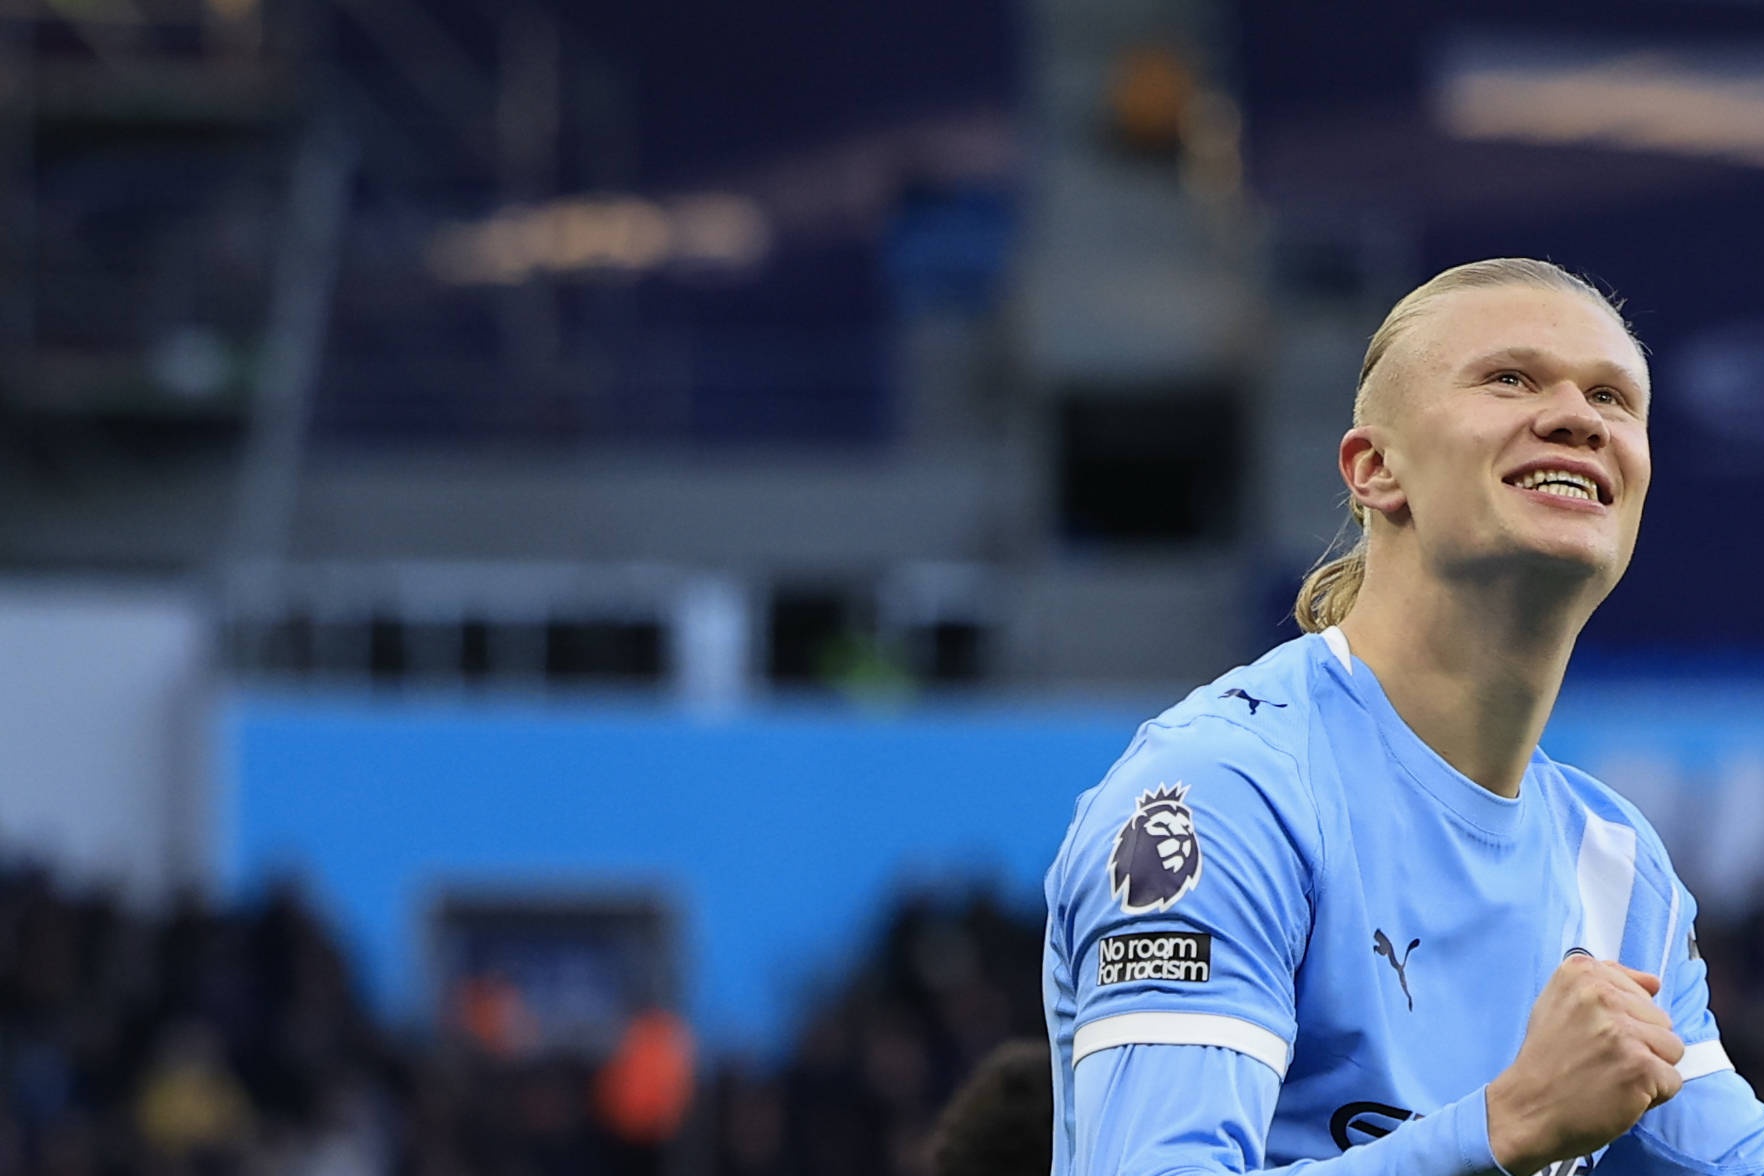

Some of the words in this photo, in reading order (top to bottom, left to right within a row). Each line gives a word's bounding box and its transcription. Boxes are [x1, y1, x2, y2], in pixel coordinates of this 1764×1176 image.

[1099, 937, 1125, 962] No
[1128, 938, 1198, 959] room
[1097, 960, 1123, 986] for
[1125, 959, 1209, 982] racism
